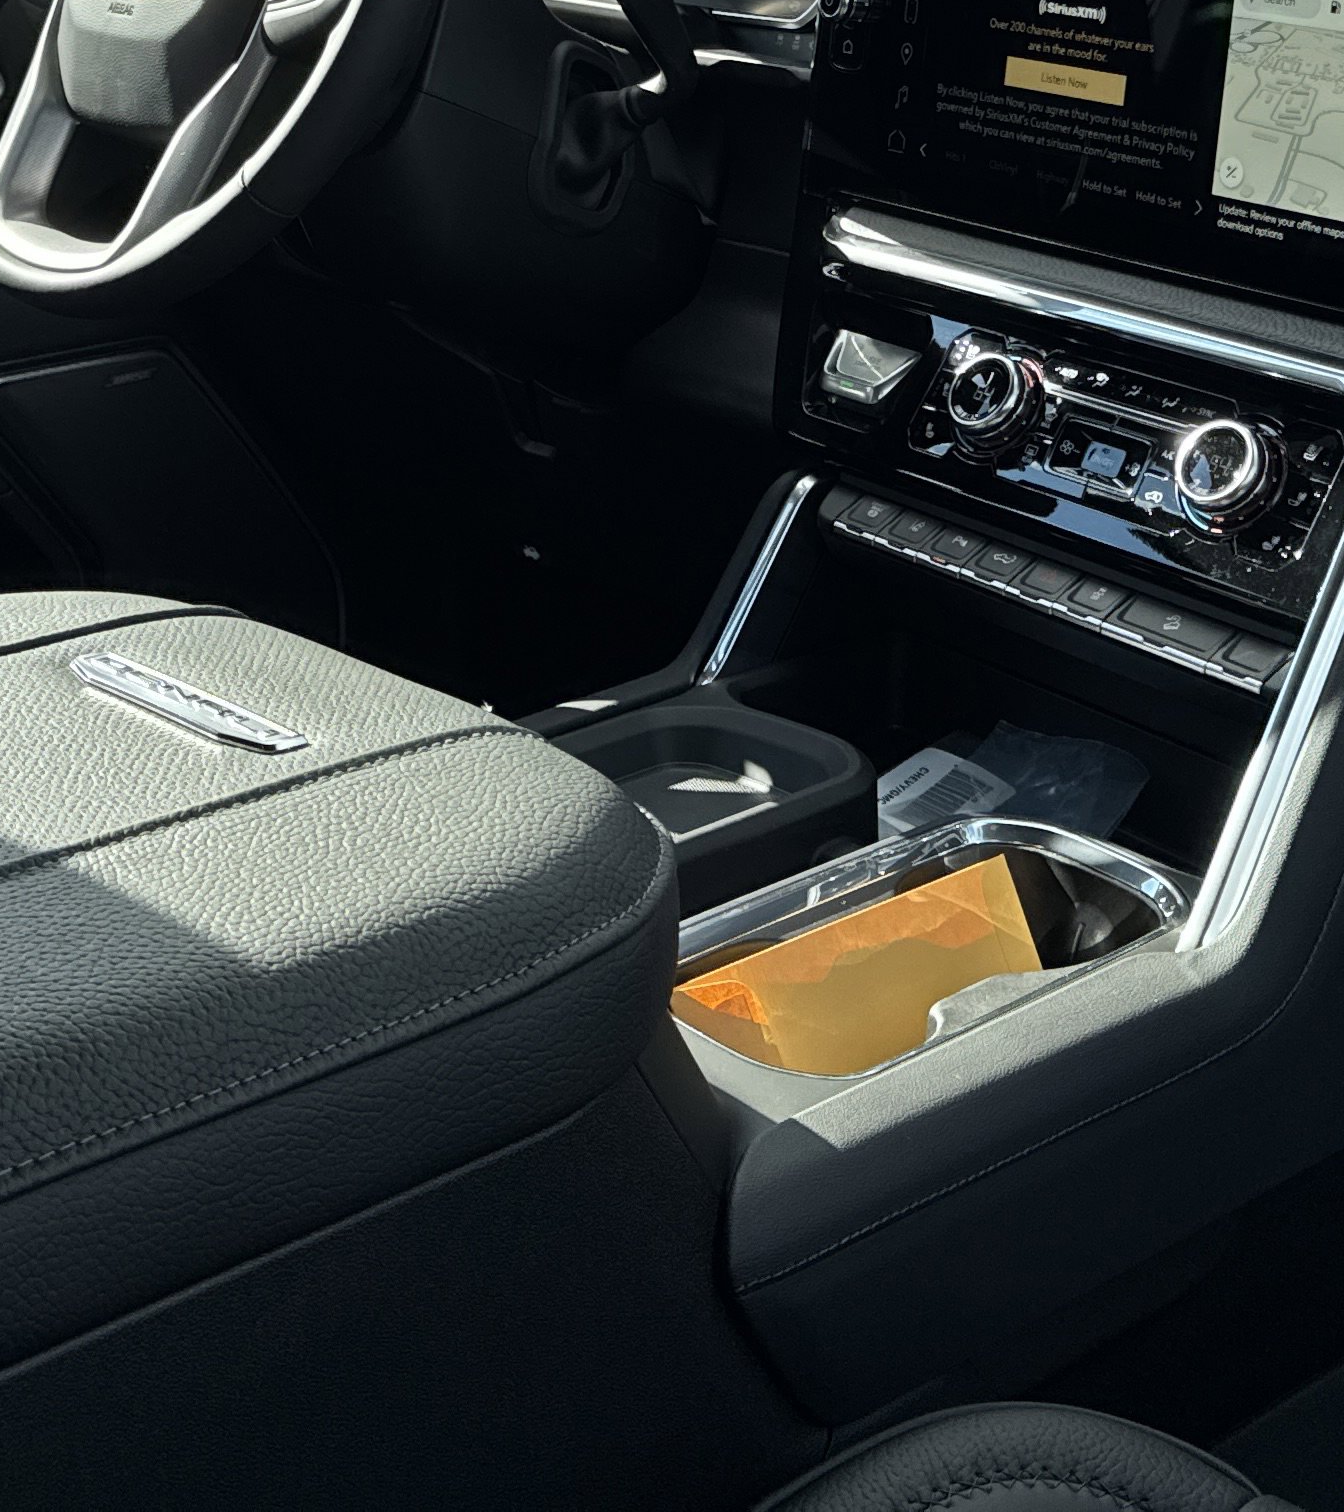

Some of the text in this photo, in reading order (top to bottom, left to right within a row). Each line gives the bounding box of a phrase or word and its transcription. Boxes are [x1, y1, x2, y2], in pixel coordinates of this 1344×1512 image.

[989, 17, 1154, 53] Over 200 channels of whatever your ears
[1027, 42, 1041, 51] are
[1042, 43, 1051, 54] in
[1051, 44, 1067, 56] the
[1066, 47, 1092, 61] mood
[1040, 71, 1089, 89] Listen Now
[936, 83, 947, 97] By
[947, 86, 979, 103] clicking
[979, 91, 1005, 105] Listen
[1027, 102, 1044, 113] you
[1045, 105, 1070, 118] agree
[1071, 108, 1089, 121] that
[1089, 113, 1110, 125] your
[1111, 116, 1130, 128] trial
[1131, 120, 1188, 140] subscription
[1189, 129, 1198, 141] is
[936, 101, 974, 116] governed
[974, 105, 986, 120] by
[1029, 116, 1072, 134] Customer
[1072, 124, 1122, 144] Agreement
[1122, 134, 1131, 146] &
[1131, 135, 1165, 155] Privacy
[1166, 142, 1196, 161] Policy
[958, 119, 983, 134] which
[982, 126, 999, 138] you
[999, 129, 1016, 139] can
[1016, 131, 1036, 144] view
[1036, 136, 1050, 146] at
[1082, 179, 1127, 198] Hold to Set
[1135, 189, 1182, 209] Hold to Set
[1216, 218, 1284, 241] download options
[1218, 203, 1249, 219] Update:
[1249, 209, 1277, 224] Review
[1277, 217, 1296, 228] your
[1296, 219, 1322, 234] offline
